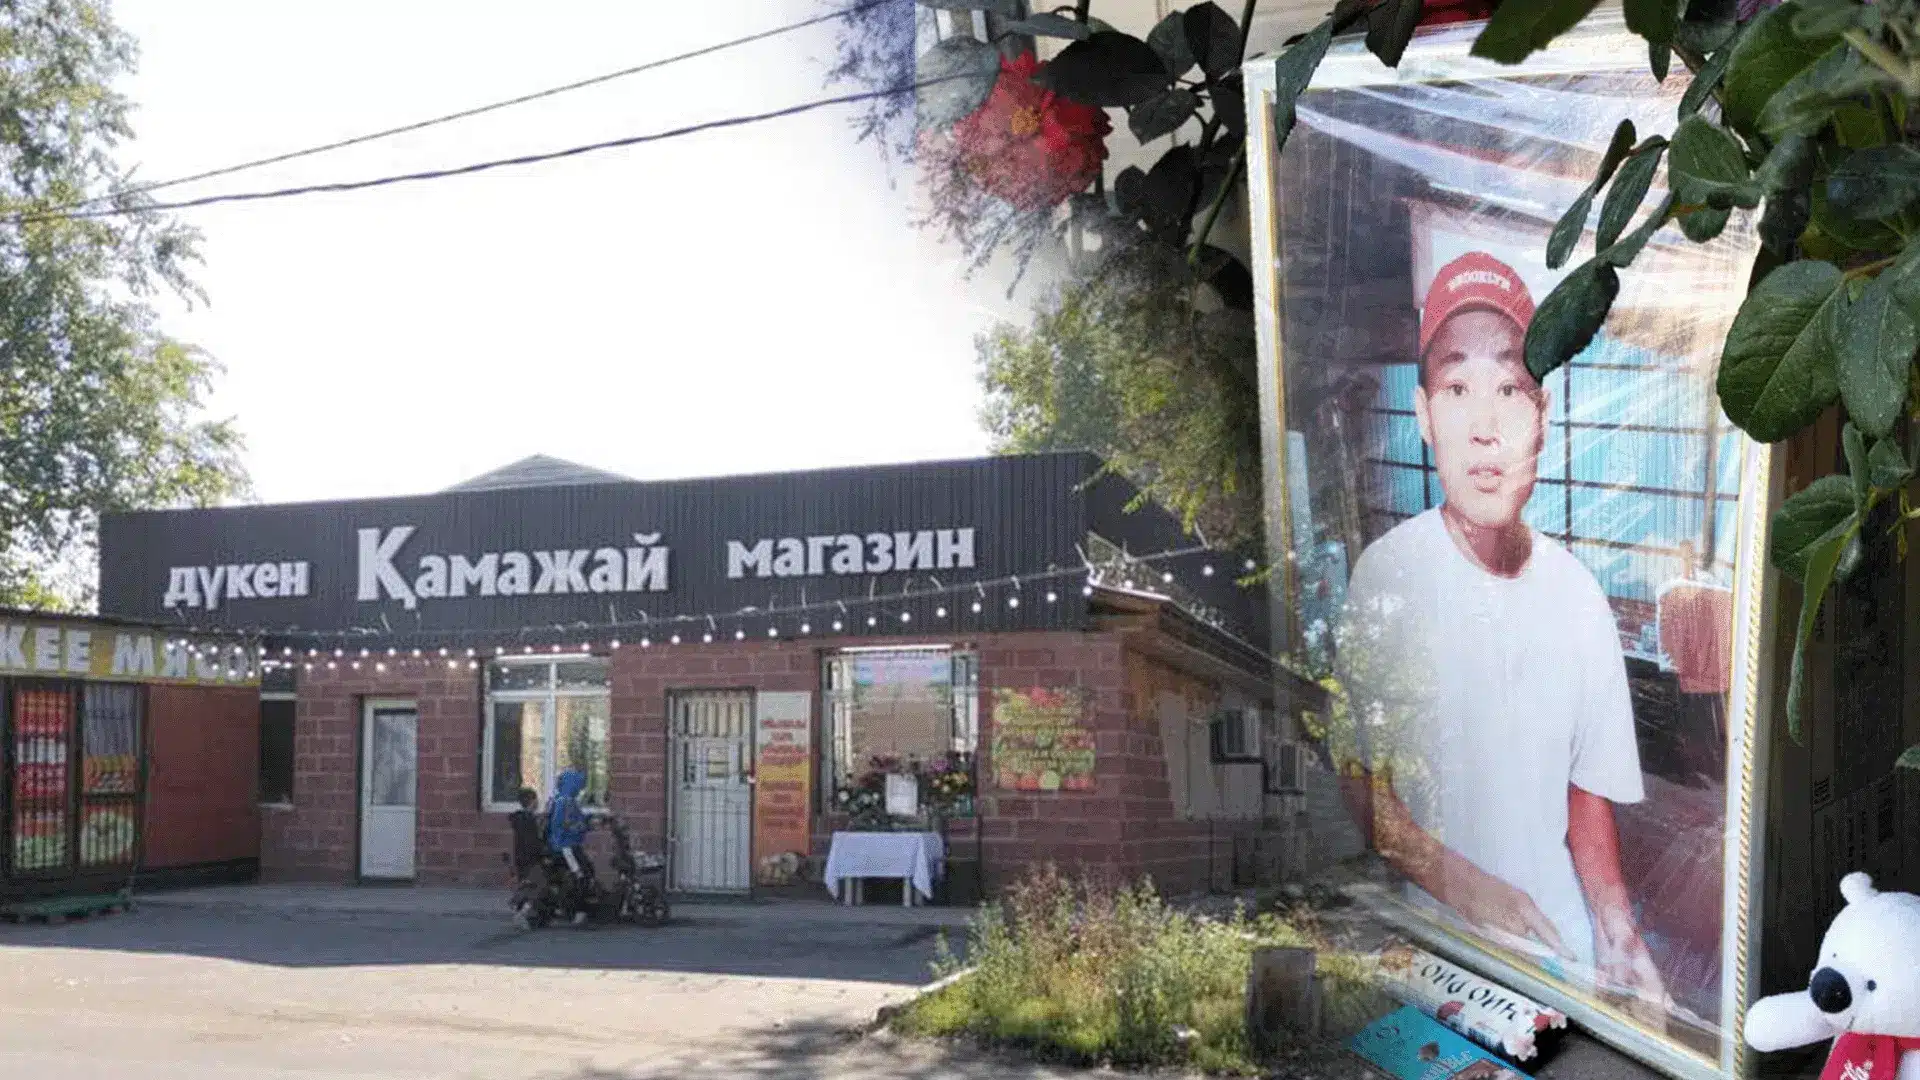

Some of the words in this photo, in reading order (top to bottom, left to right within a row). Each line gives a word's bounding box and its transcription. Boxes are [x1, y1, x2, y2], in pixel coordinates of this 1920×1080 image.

[1445, 269, 1512, 293] BROOKLYN
[357, 525, 669, 609] Қамажай
[727, 527, 976, 579] магазин
